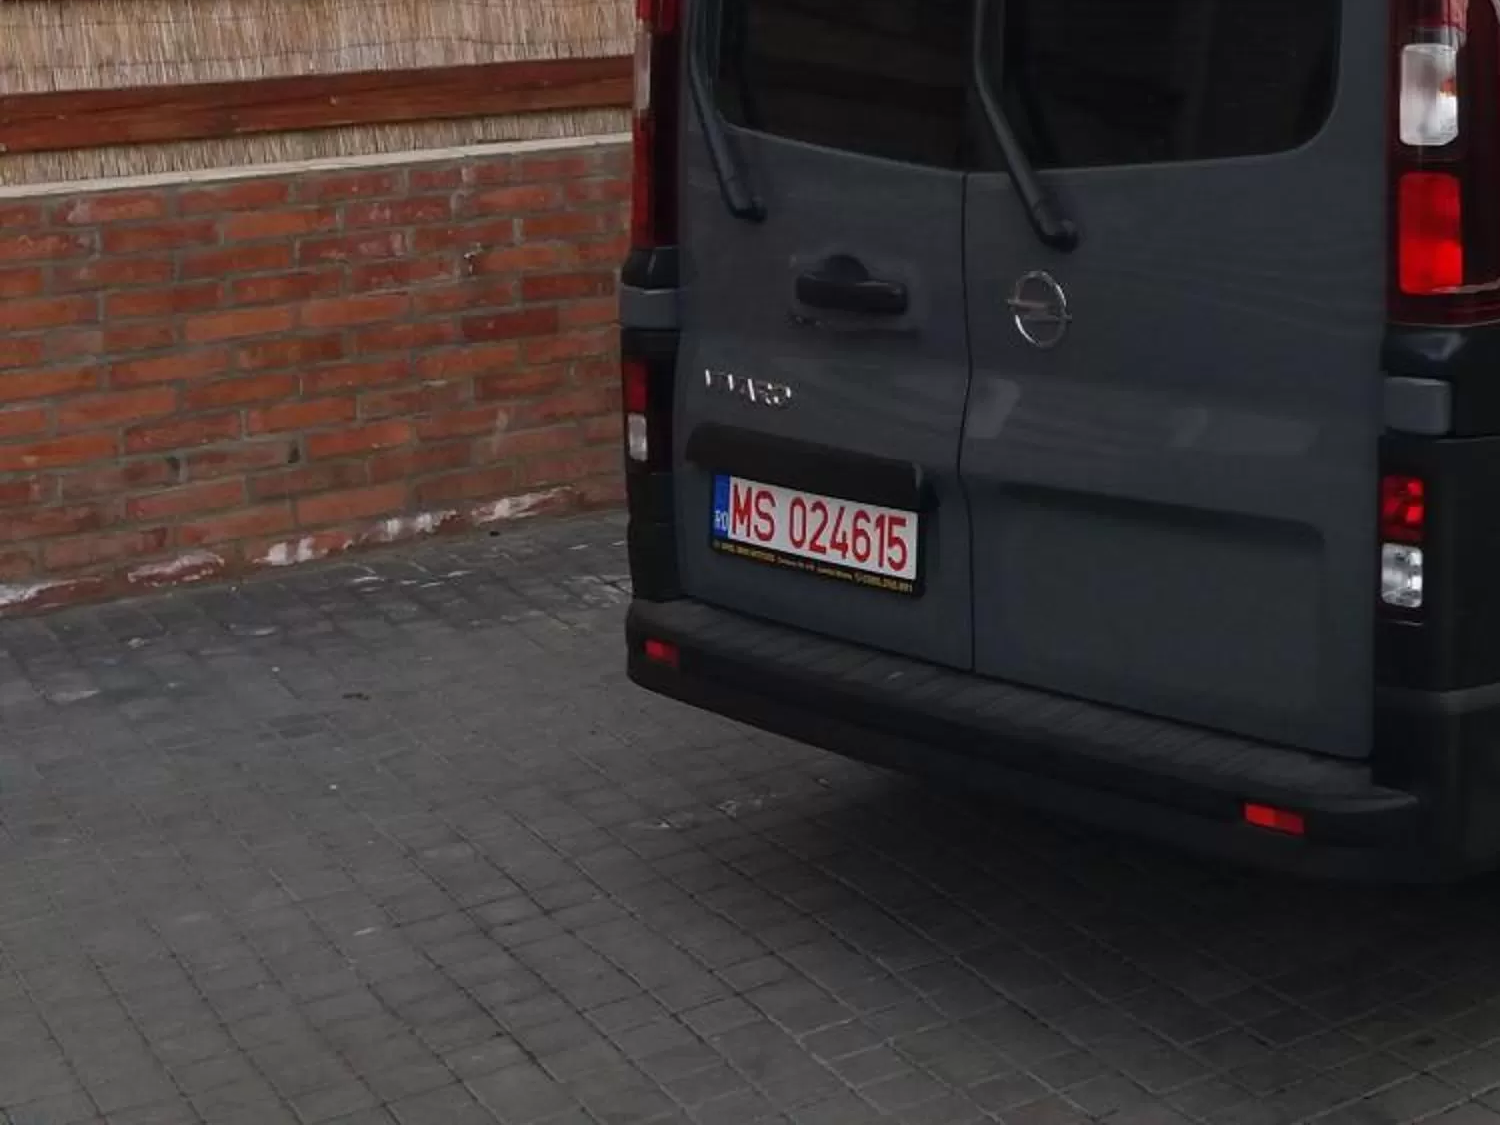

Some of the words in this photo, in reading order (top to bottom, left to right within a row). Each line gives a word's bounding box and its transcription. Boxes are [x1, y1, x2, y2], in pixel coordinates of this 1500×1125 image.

[704, 368, 792, 407] VVARO
[732, 483, 776, 542] MS
[789, 497, 907, 571] 024615
